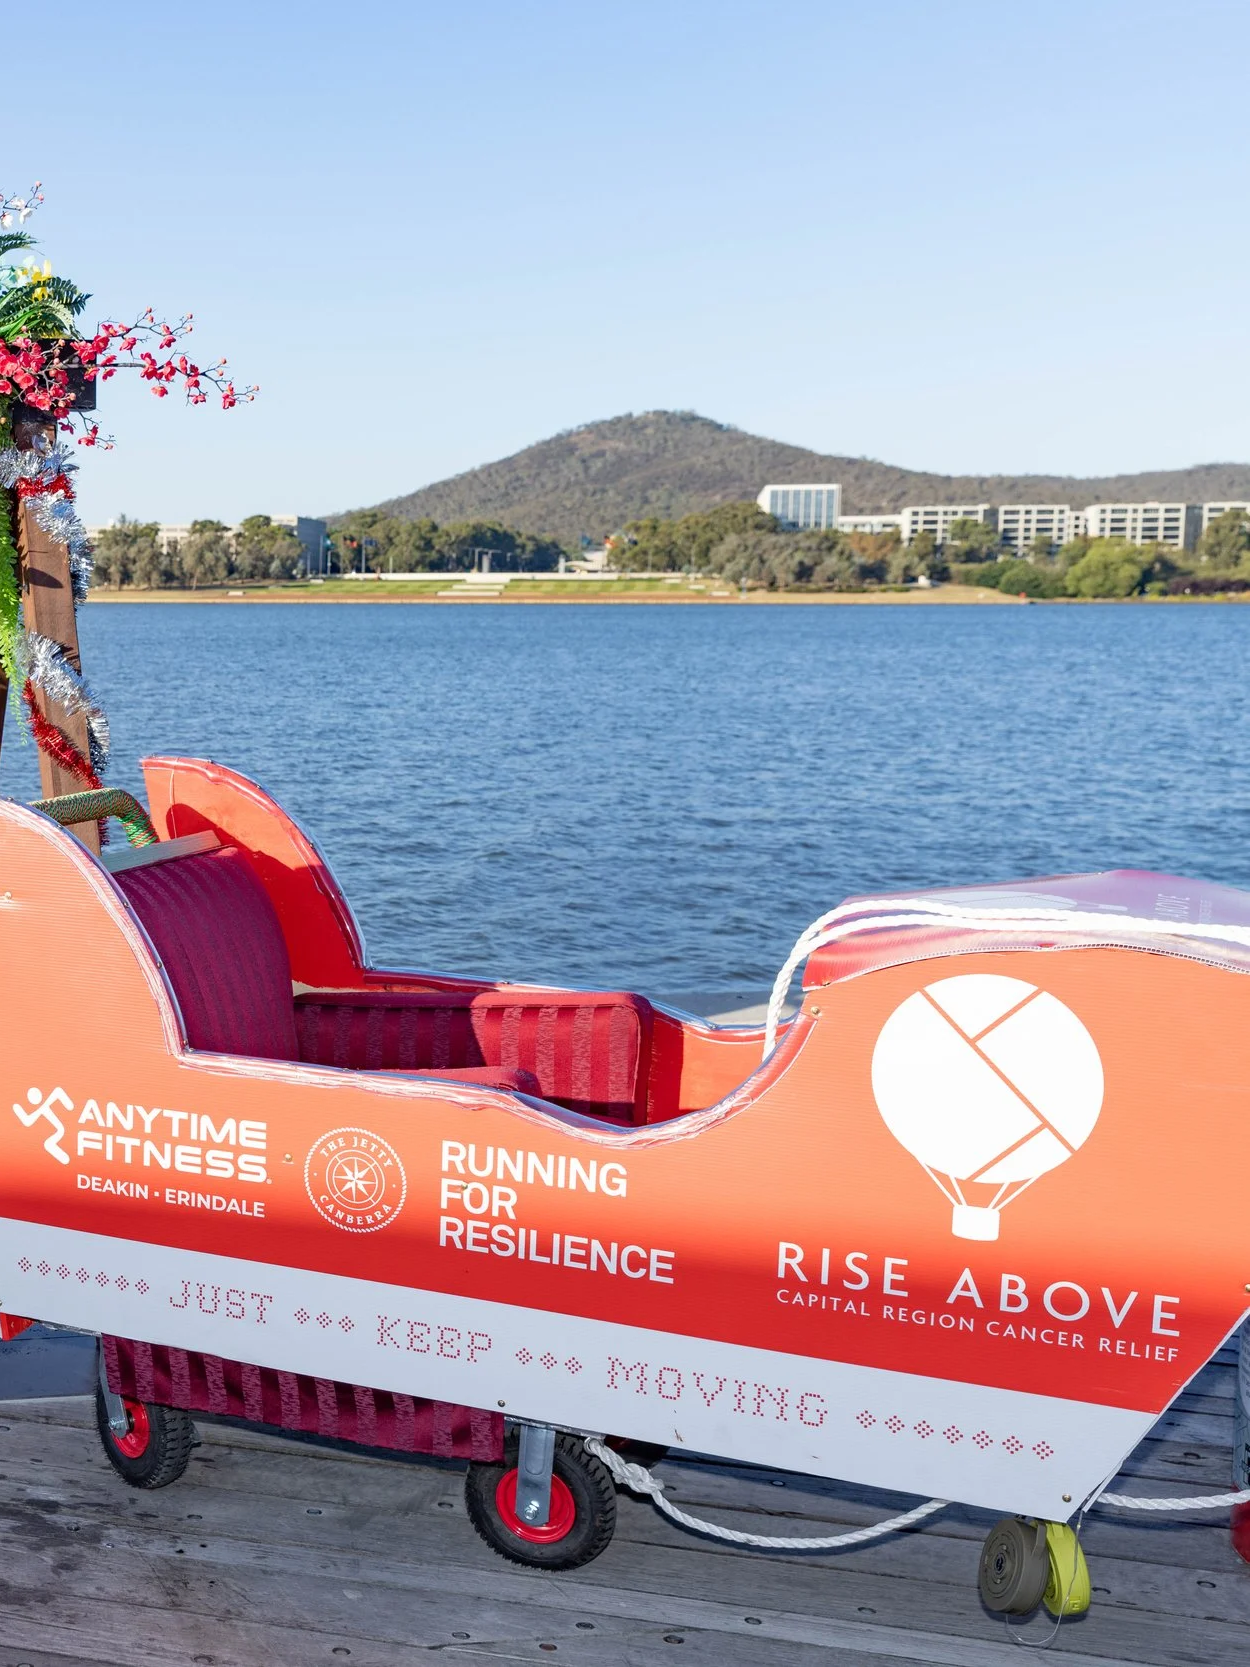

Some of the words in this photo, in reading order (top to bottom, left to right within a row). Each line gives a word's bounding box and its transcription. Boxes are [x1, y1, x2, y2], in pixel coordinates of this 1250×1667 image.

[78, 1098, 267, 1150] ANYTIME
[77, 1130, 267, 1183] FITNESS
[320, 1137, 346, 1157] THE
[352, 1136, 393, 1167] JETTY
[441, 1139, 628, 1197] RUNNING
[77, 1173, 149, 1200] DEAKIN
[165, 1187, 266, 1218] ERINDALE
[319, 1194, 392, 1225] CANBERRA
[440, 1177, 518, 1220] FOR
[439, 1215, 675, 1284] RESILIENCE
[776, 1241, 910, 1298] RISE
[946, 1267, 1181, 1337] ABOVE
[776, 1289, 871, 1318] CAPITAL
[883, 1305, 976, 1333] REGION
[986, 1320, 1085, 1350] CANCER
[1098, 1337, 1179, 1363] RELIEF
[169, 1280, 273, 1324] JUST
[376, 1315, 492, 1363] KEEP
[607, 1356, 828, 1428] MOVING
